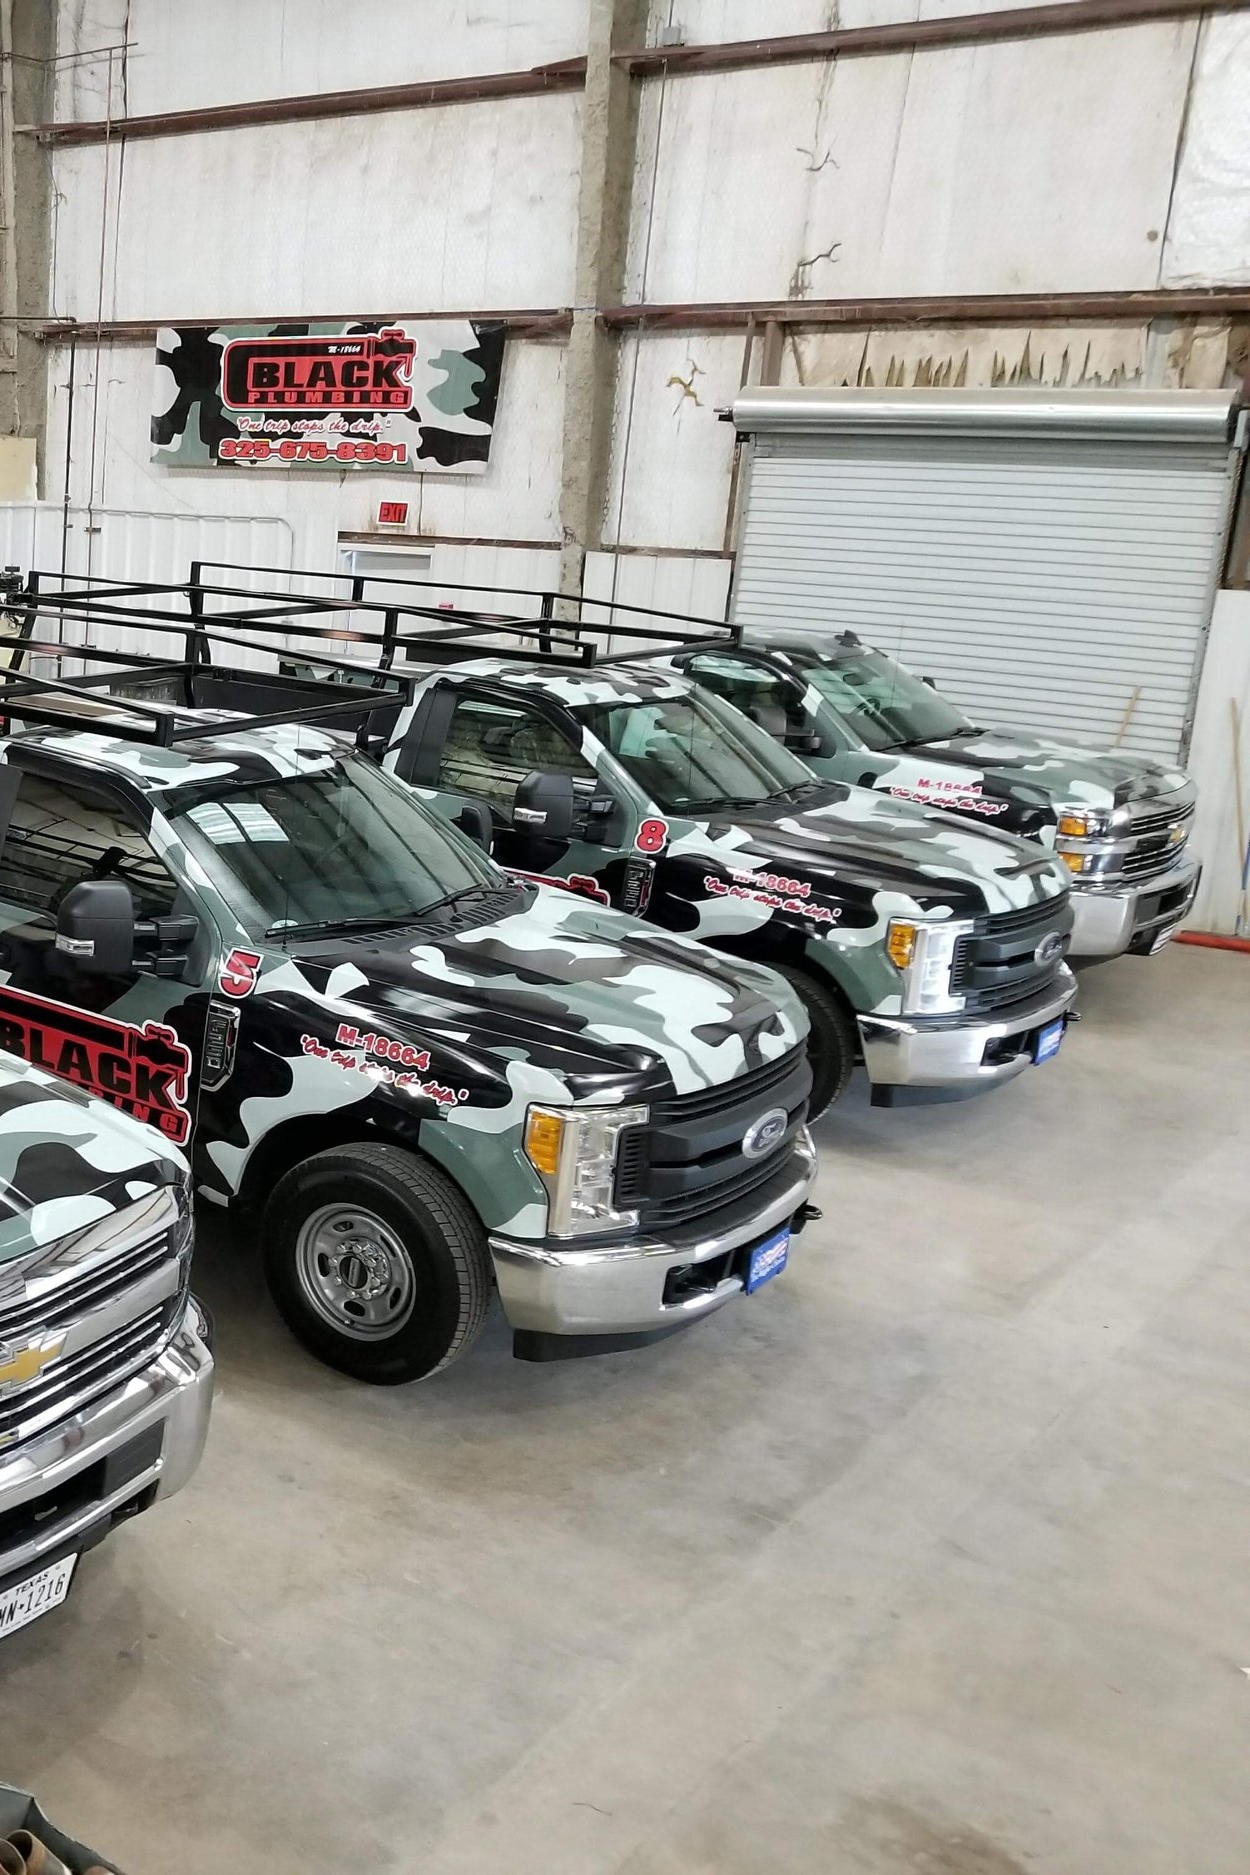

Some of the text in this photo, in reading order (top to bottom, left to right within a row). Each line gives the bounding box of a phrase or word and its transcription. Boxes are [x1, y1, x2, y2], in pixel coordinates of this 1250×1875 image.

[252, 360, 401, 389] BLACK
[248, 391, 406, 405] PLUMBING
[264, 418, 289, 434] trip
[292, 419, 324, 434] stops
[328, 419, 347, 432] the
[220, 440, 407, 463] 325-675-8391
[381, 503, 407, 523] EXIT
[636, 819, 668, 853] 8
[220, 949, 262, 997] 5
[336, 1023, 431, 1071] M-18664
[15, 1571, 50, 1596] TEXAS
